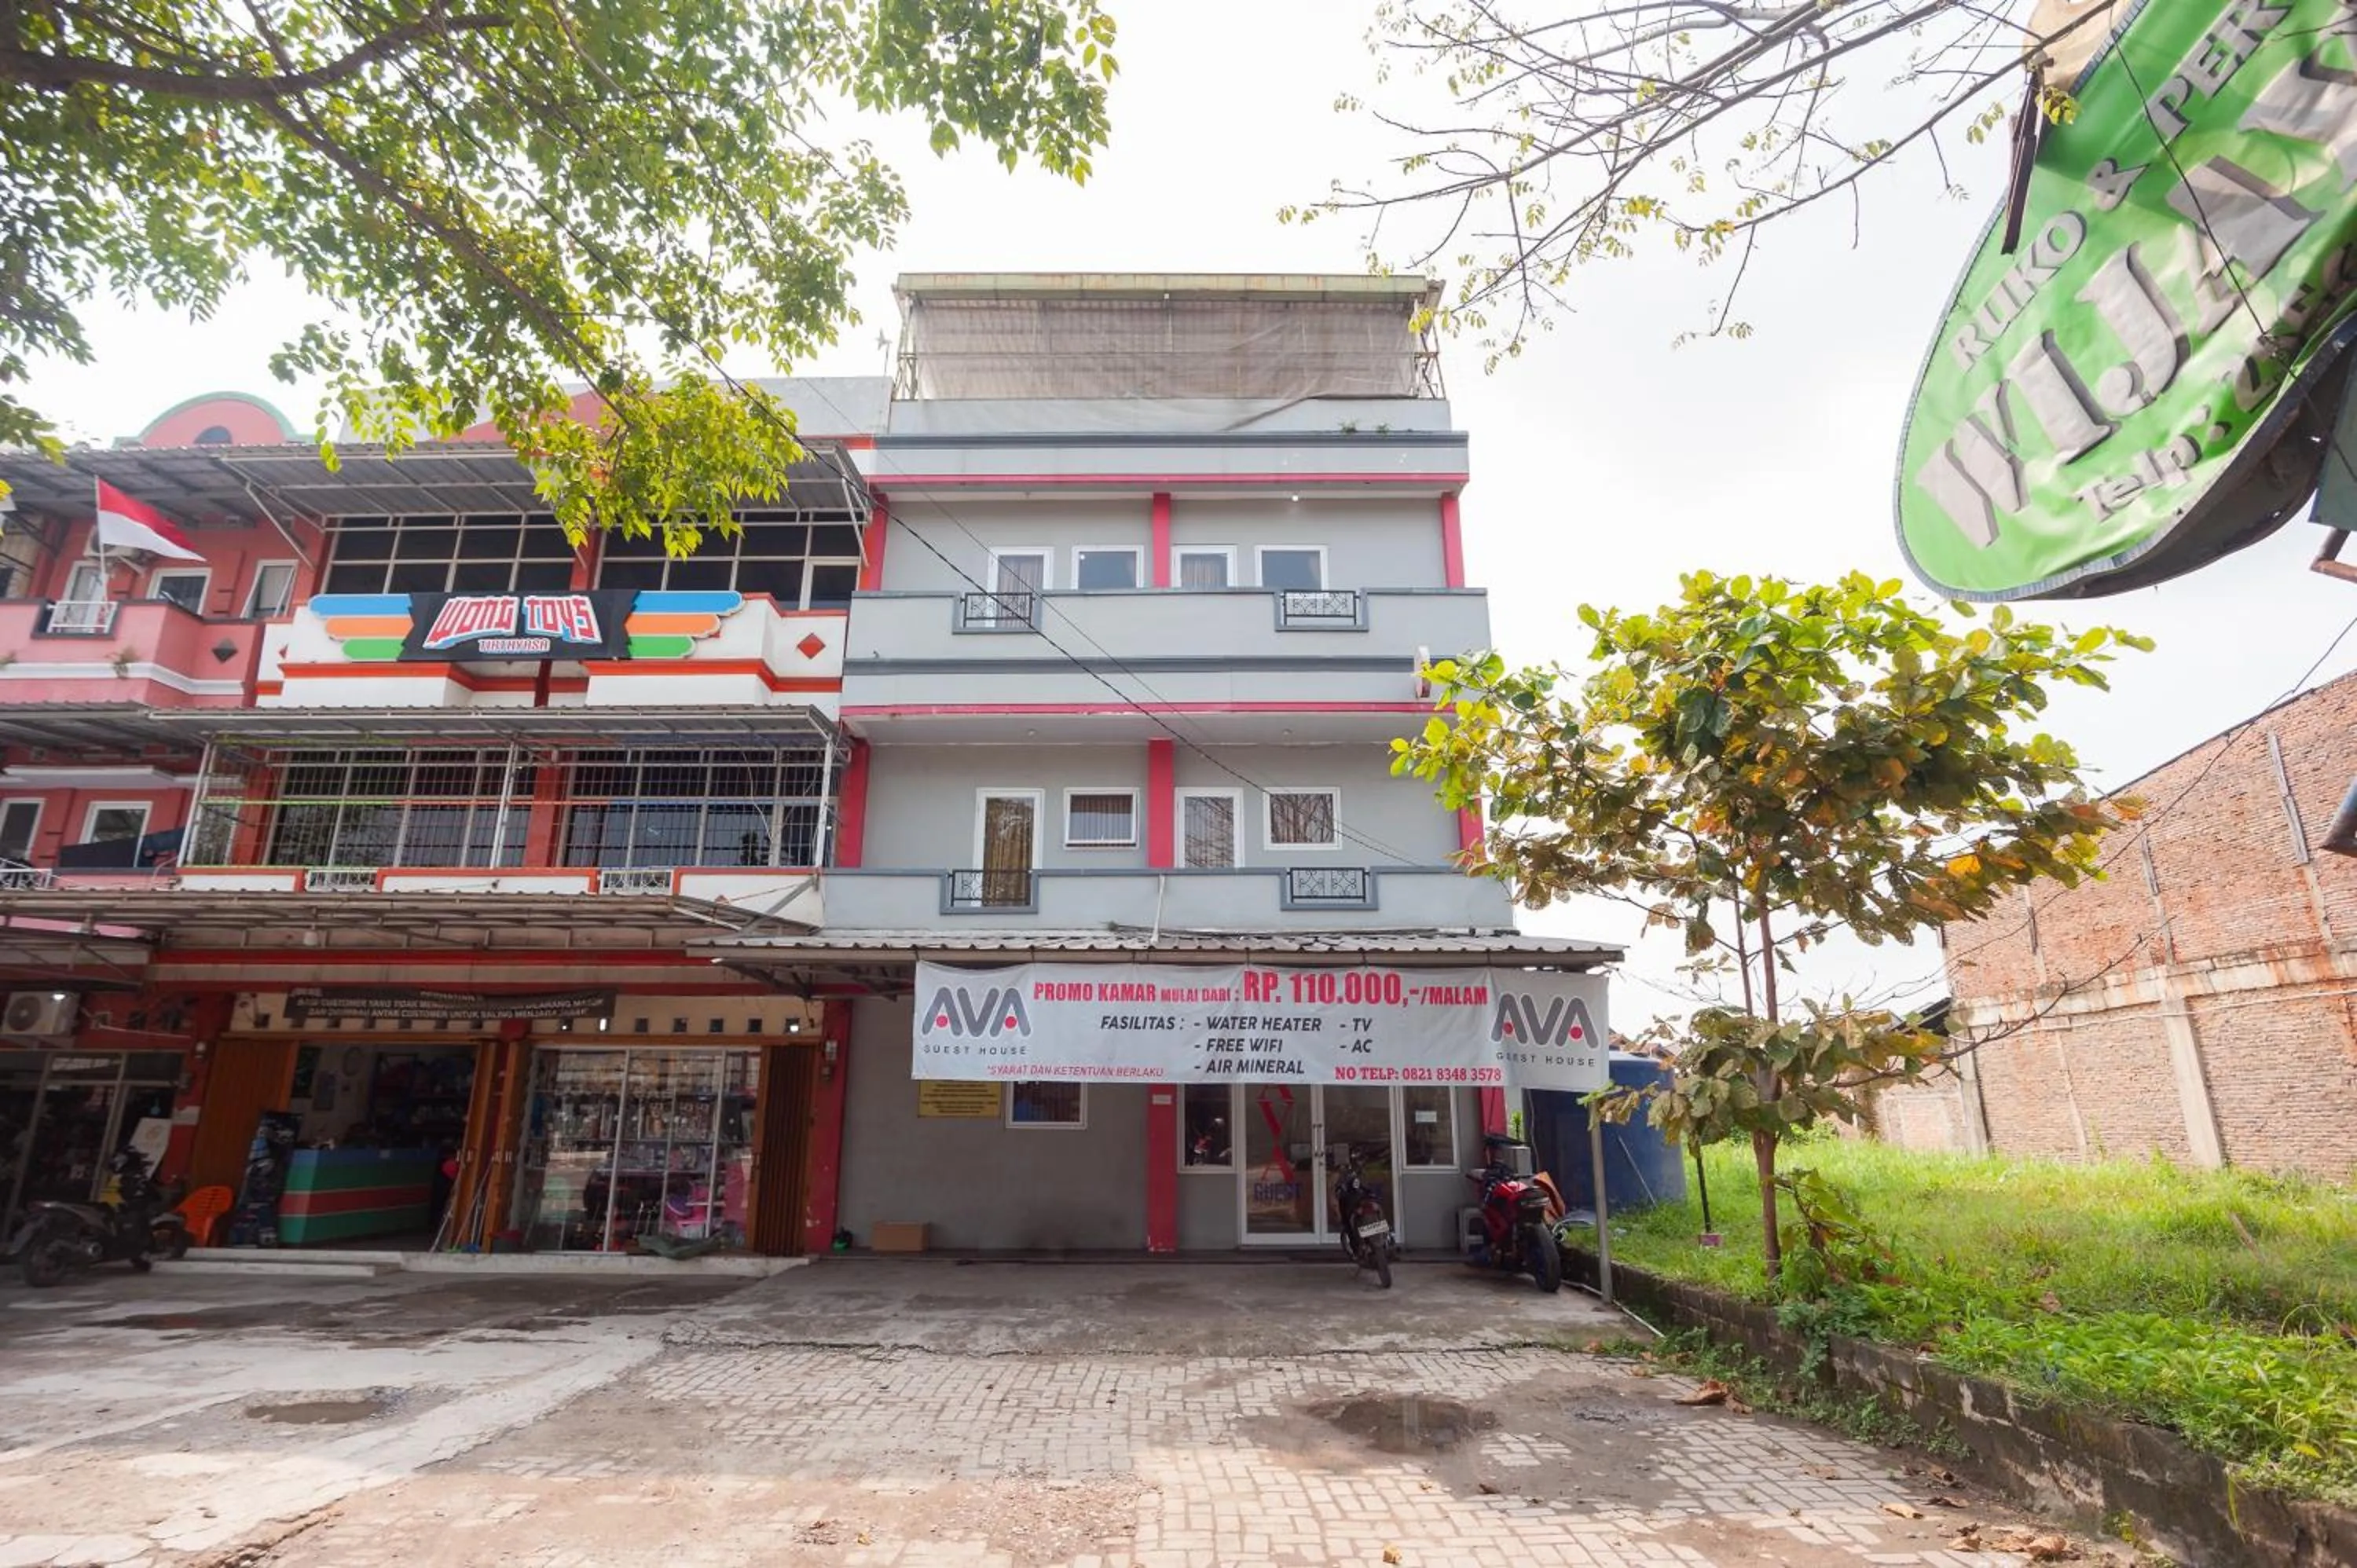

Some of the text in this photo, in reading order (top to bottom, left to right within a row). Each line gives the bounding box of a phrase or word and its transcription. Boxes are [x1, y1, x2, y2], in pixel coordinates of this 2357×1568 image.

[1948, 210, 2088, 372] RUKO
[2085, 158, 2150, 211] &
[523, 595, 603, 643] TOYS
[1034, 981, 1094, 1002] PROMO
[1098, 983, 1157, 1002] KAMAR
[1160, 987, 1198, 1002] MULAI
[1201, 987, 1231, 1002] DARI
[1244, 970, 1282, 1003] RP.
[922, 986, 1032, 1038] AVA
[1100, 1015, 1176, 1031] FASILITAS
[1206, 1016, 1258, 1031] WATER
[1261, 1017, 1322, 1031] HEATER
[1352, 1017, 1373, 1032] TV
[1491, 993, 1599, 1049] AVA
[923, 1044, 1027, 1055] GUEST HOUSE
[1206, 1038, 1245, 1053] FREE
[1249, 1038, 1283, 1053] WIFI
[1351, 1039, 1373, 1053] AC
[1206, 1058, 1233, 1073] AIR
[1236, 1059, 1305, 1075] MINERAL
[1545, 1055, 1595, 1067] HOUSE
[1030, 1064, 1051, 1075] DAN
[1054, 1065, 1113, 1077] KETENTUAN
[1116, 1067, 1164, 1077] BERLAKU
[1335, 1066, 1501, 1081] NO TELP: 0821 8348 3578
